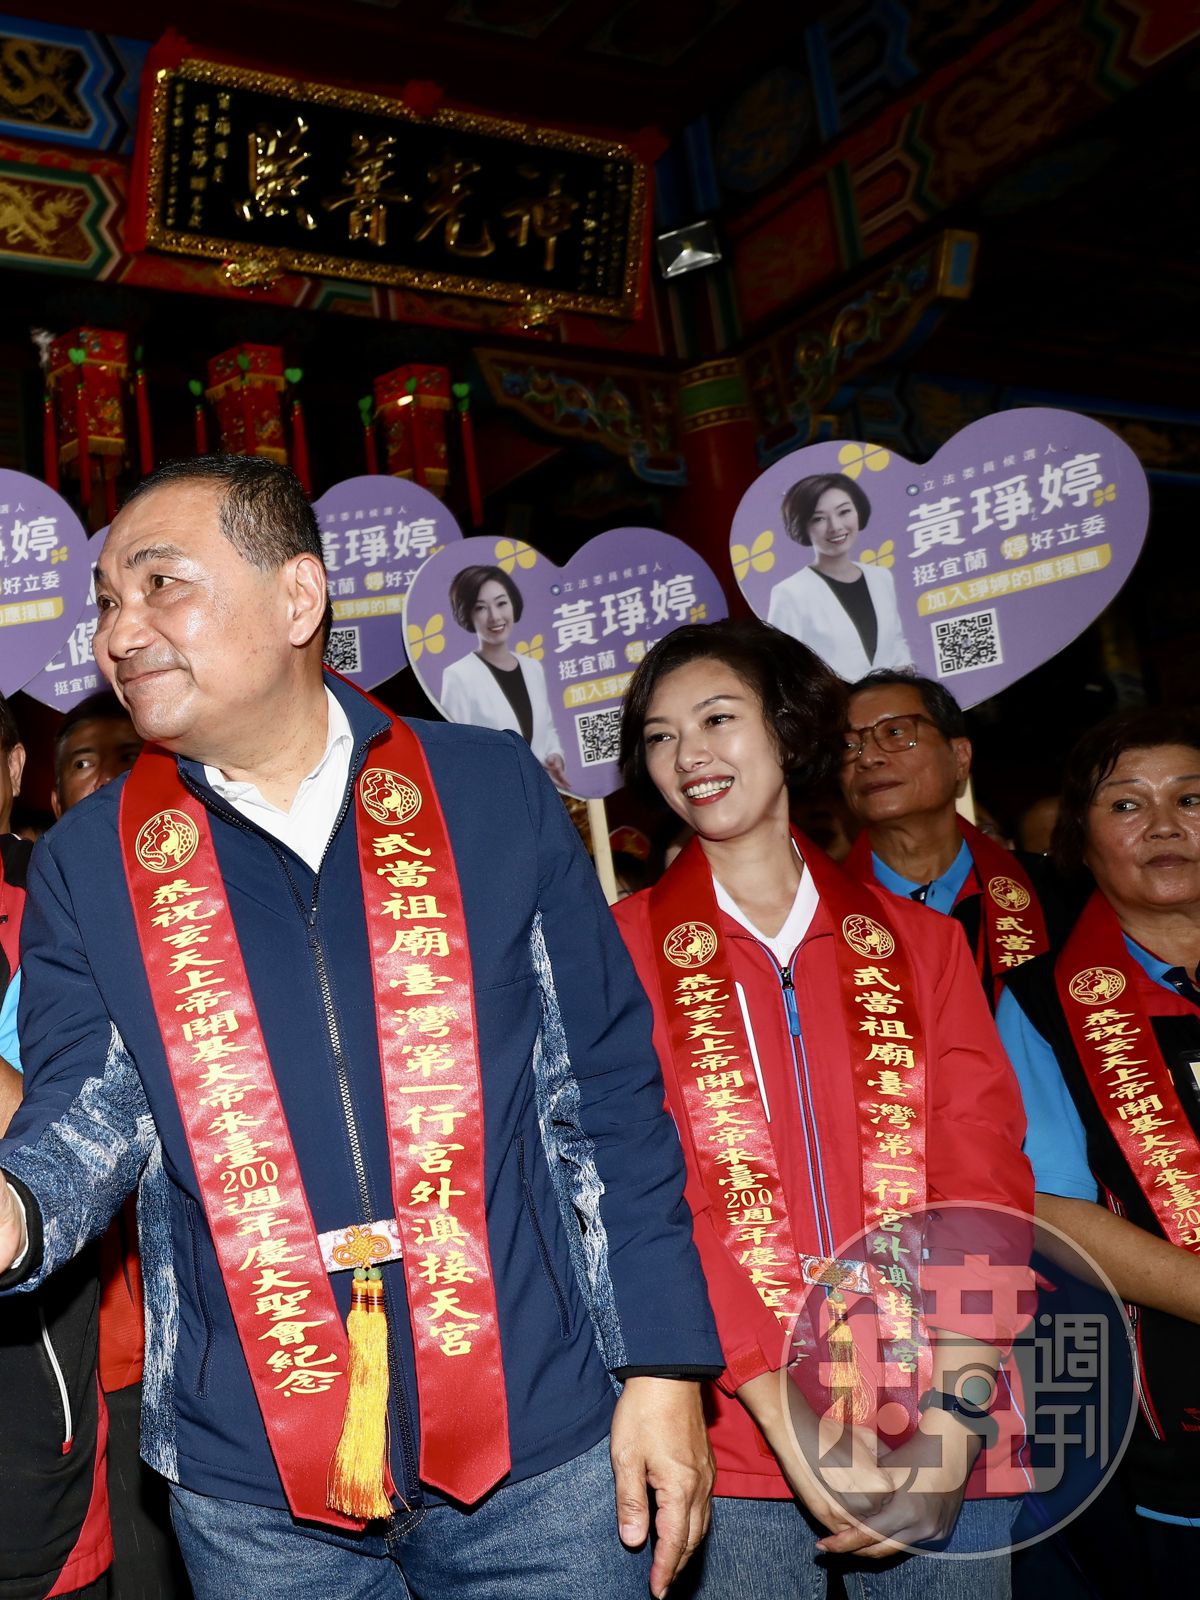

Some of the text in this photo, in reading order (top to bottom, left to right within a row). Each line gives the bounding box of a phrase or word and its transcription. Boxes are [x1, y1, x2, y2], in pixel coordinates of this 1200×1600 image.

[923, 443, 1057, 492] 立法委員候選人
[906, 453, 1104, 559] 黃琤婷
[564, 561, 663, 593] 立法委員候選人
[912, 514, 1107, 587] 挺宜蘭 婷好立委
[552, 574, 697, 653] 黃琤婷
[54, 674, 98, 697] 挺宜蘭
[559, 650, 617, 681] 挺宜蘭
[372, 832, 481, 1358] 武當祖廟臺灣第一行宮外澳接天宮
